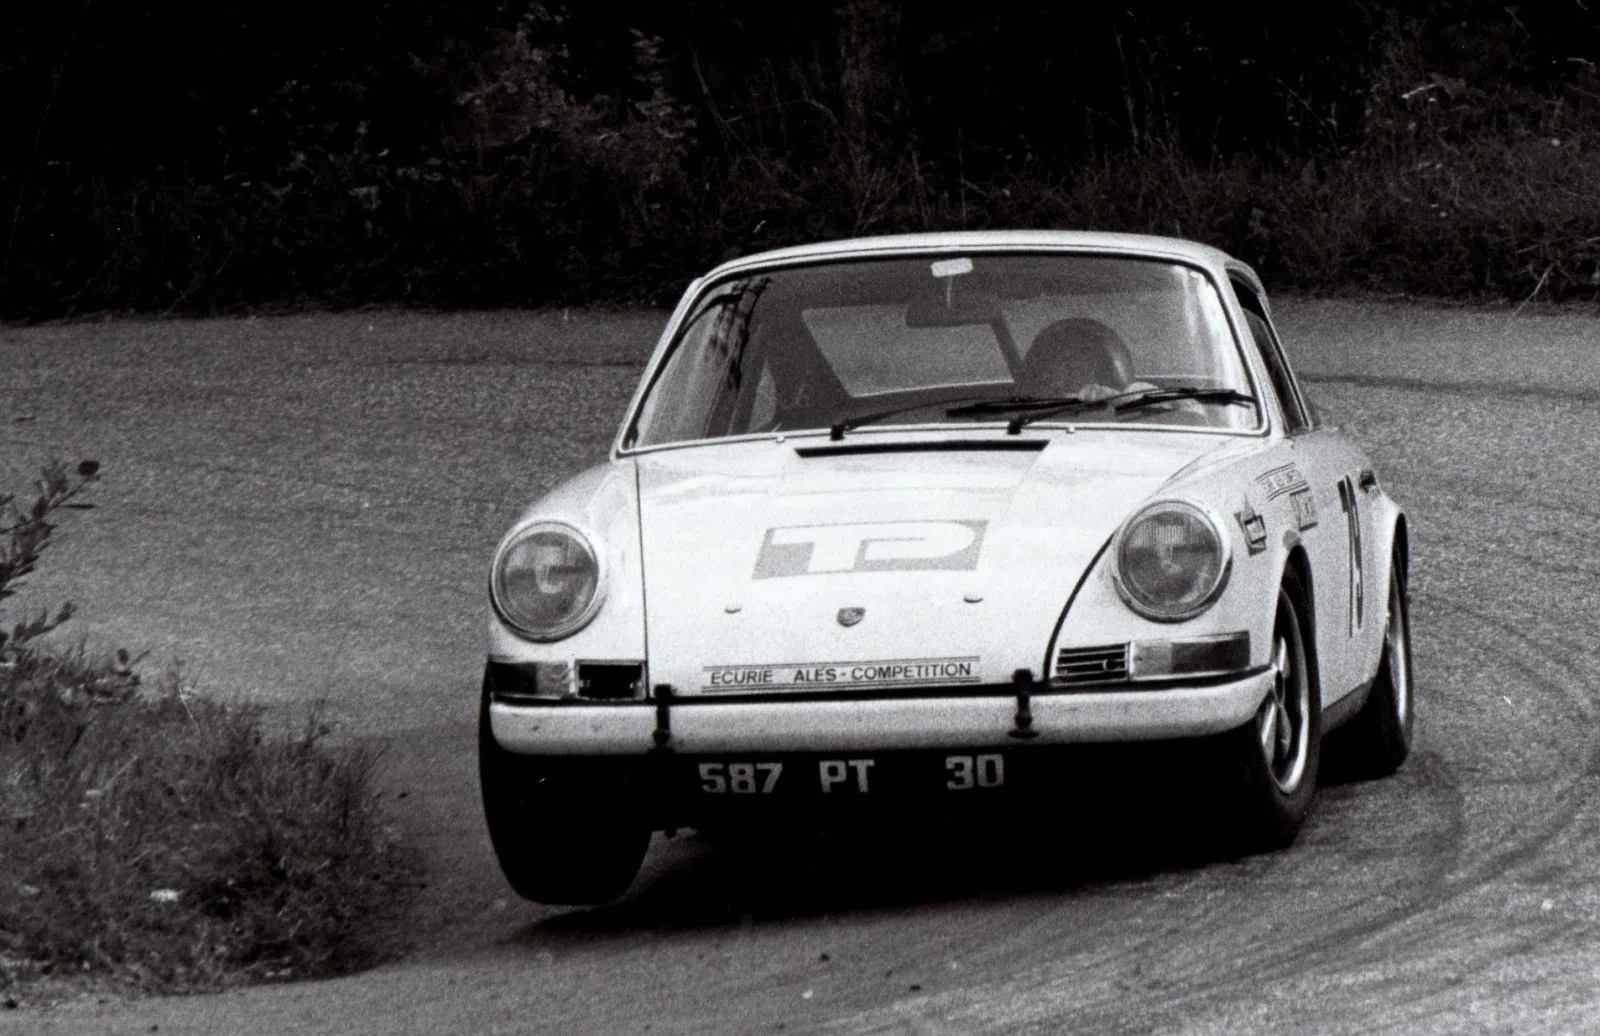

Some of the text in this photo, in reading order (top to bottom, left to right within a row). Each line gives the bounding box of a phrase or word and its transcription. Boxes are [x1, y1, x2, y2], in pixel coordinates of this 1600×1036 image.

[711, 670, 773, 685] ECURIE
[698, 754, 1004, 793] 587 PT 30
